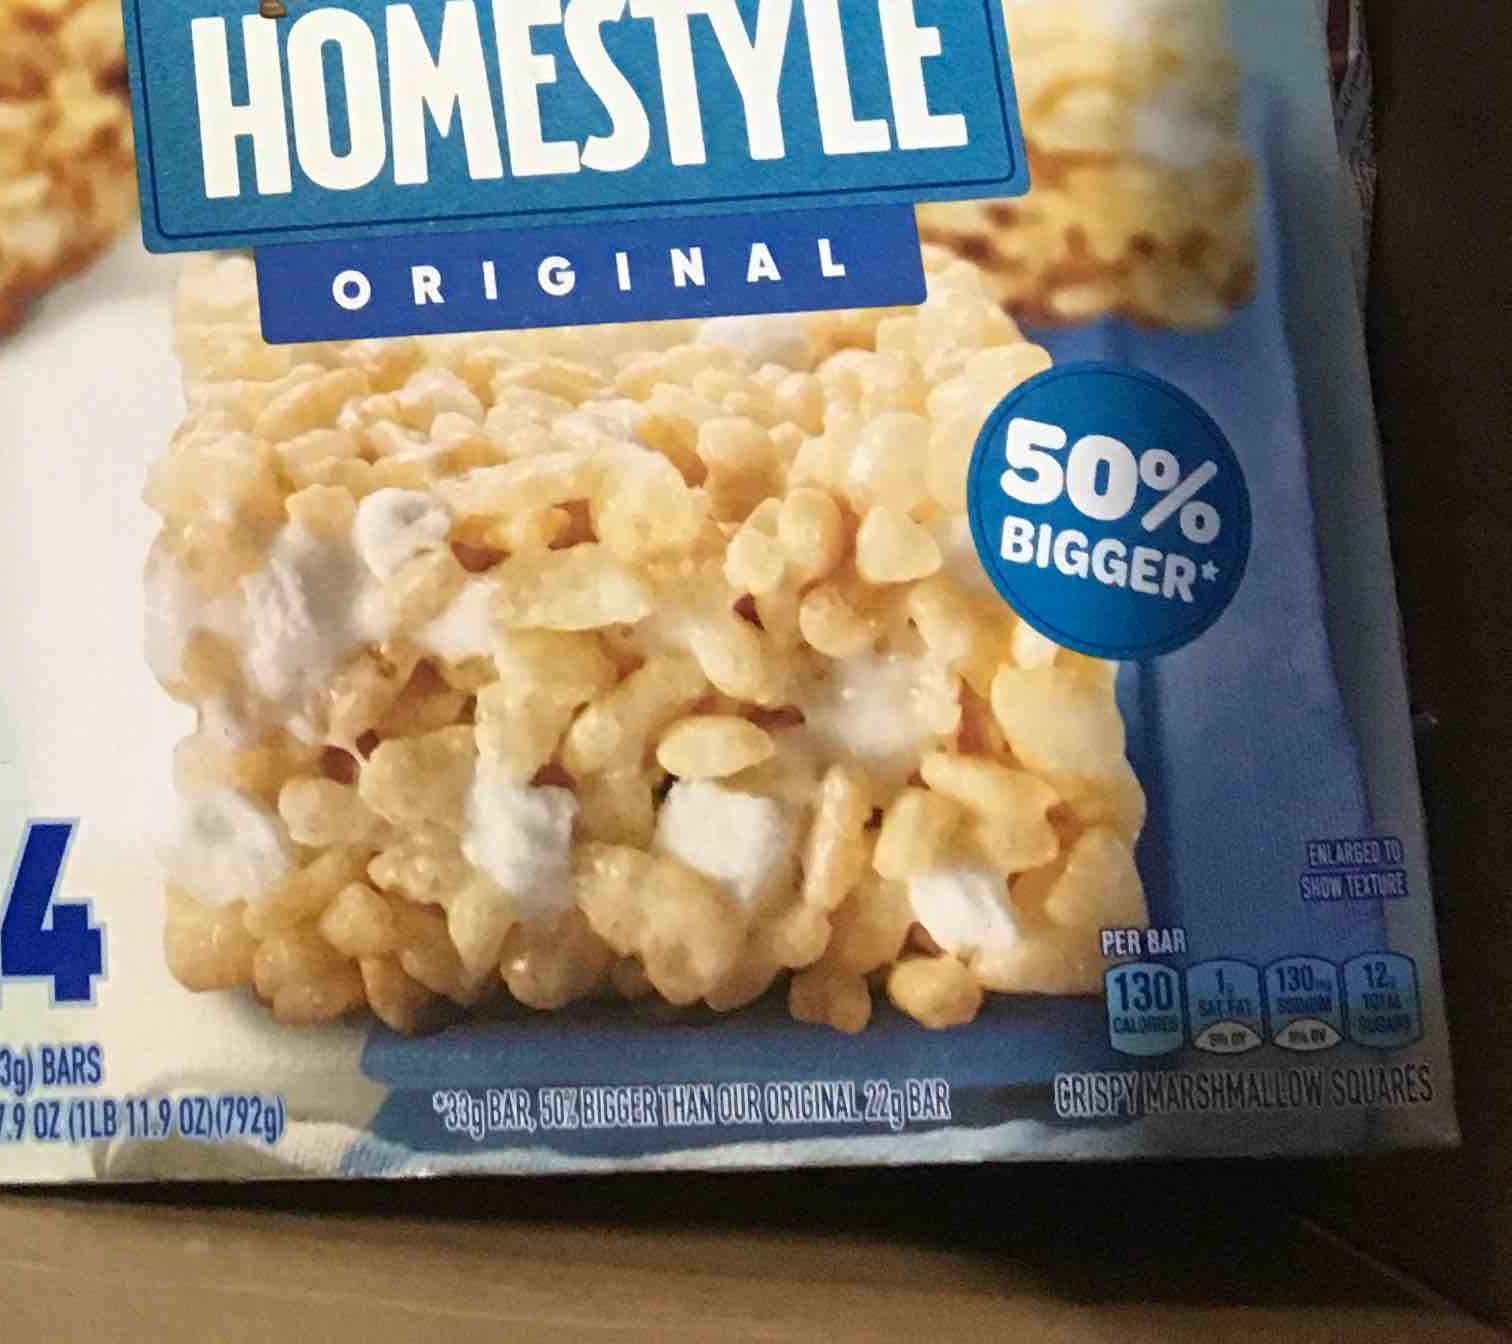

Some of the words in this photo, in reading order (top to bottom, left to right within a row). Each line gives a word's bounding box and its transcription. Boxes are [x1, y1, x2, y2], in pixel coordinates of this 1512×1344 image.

[331, 231, 846, 318] ORIGINAL
[999, 416, 1221, 543] 50%
[1308, 837, 1379, 867] ENLARGED
[1301, 875, 1342, 900] SHOW
[1346, 871, 1407, 897] TEXTURE
[1101, 928, 1141, 956] PER
[1147, 927, 1186, 954] BAR
[1114, 969, 1173, 1012] 130
[42, 1048, 101, 1086] BARS
[540, 1086, 579, 1129] 50%
[580, 1084, 658, 1128] BIGGER
[660, 1083, 715, 1127] THAN
[718, 1081, 763, 1124] OUR
[765, 1079, 860, 1124] ORIGINAL
[864, 1078, 905, 1129] 22g
[907, 1078, 950, 1121] BAR
[1055, 1072, 1138, 1120] CRISPY
[1144, 1068, 1322, 1113] MARSHMALLOW
[1331, 1064, 1433, 1105] SQUARES
[33, 1100, 60, 1142] OZ
[68, 1099, 116, 1142] (1LB
[126, 1098, 171, 1139] 11.9
